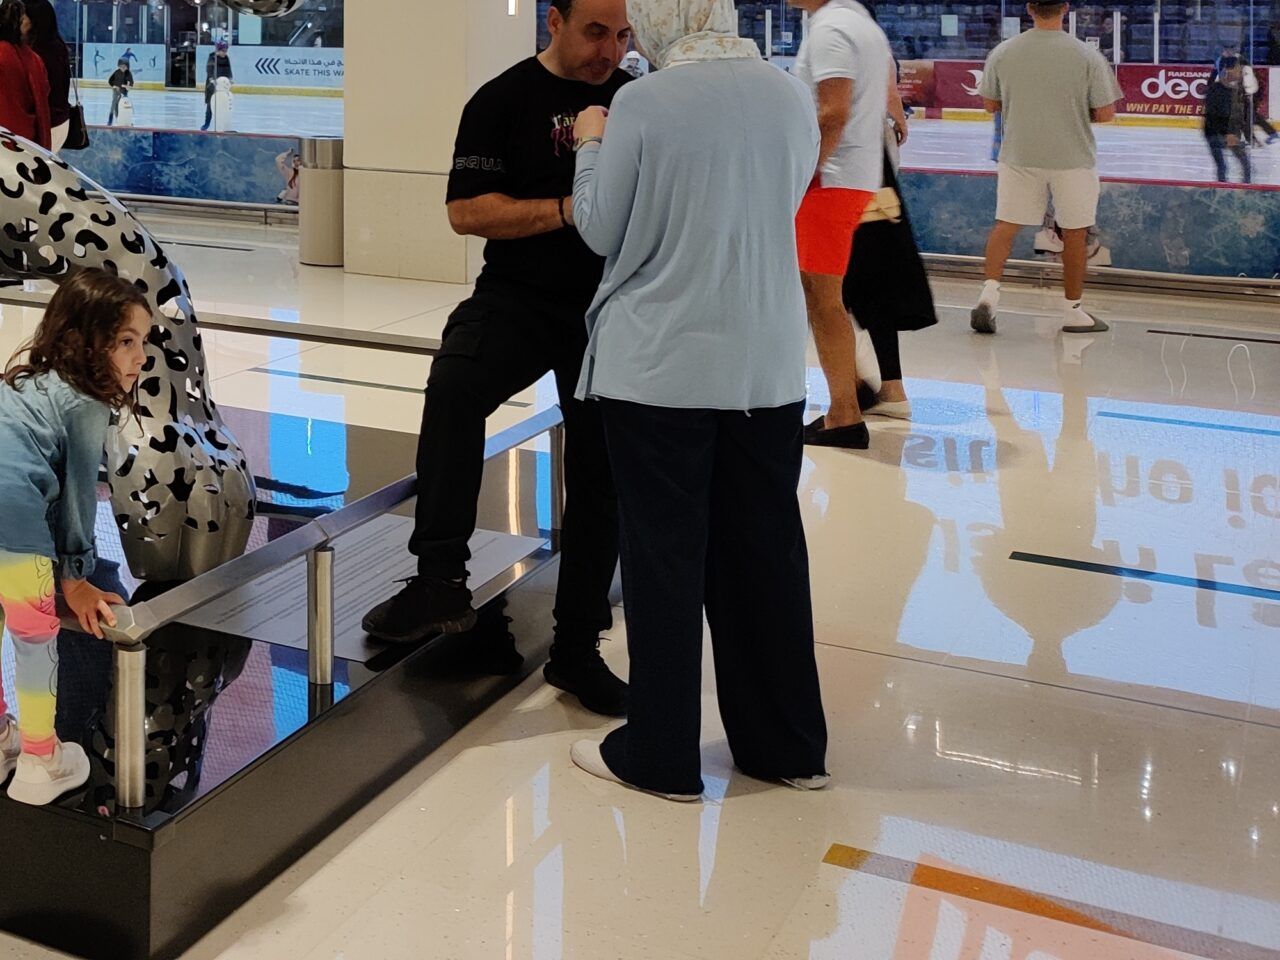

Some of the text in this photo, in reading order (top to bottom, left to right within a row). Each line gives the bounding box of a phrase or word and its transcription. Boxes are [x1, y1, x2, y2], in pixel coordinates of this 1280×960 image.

[284, 68, 311, 76] SKATE
[313, 69, 331, 77] THIS
[1126, 102, 1151, 113] WHY
[1152, 104, 1171, 114] PAY
[1174, 105, 1192, 114] THE
